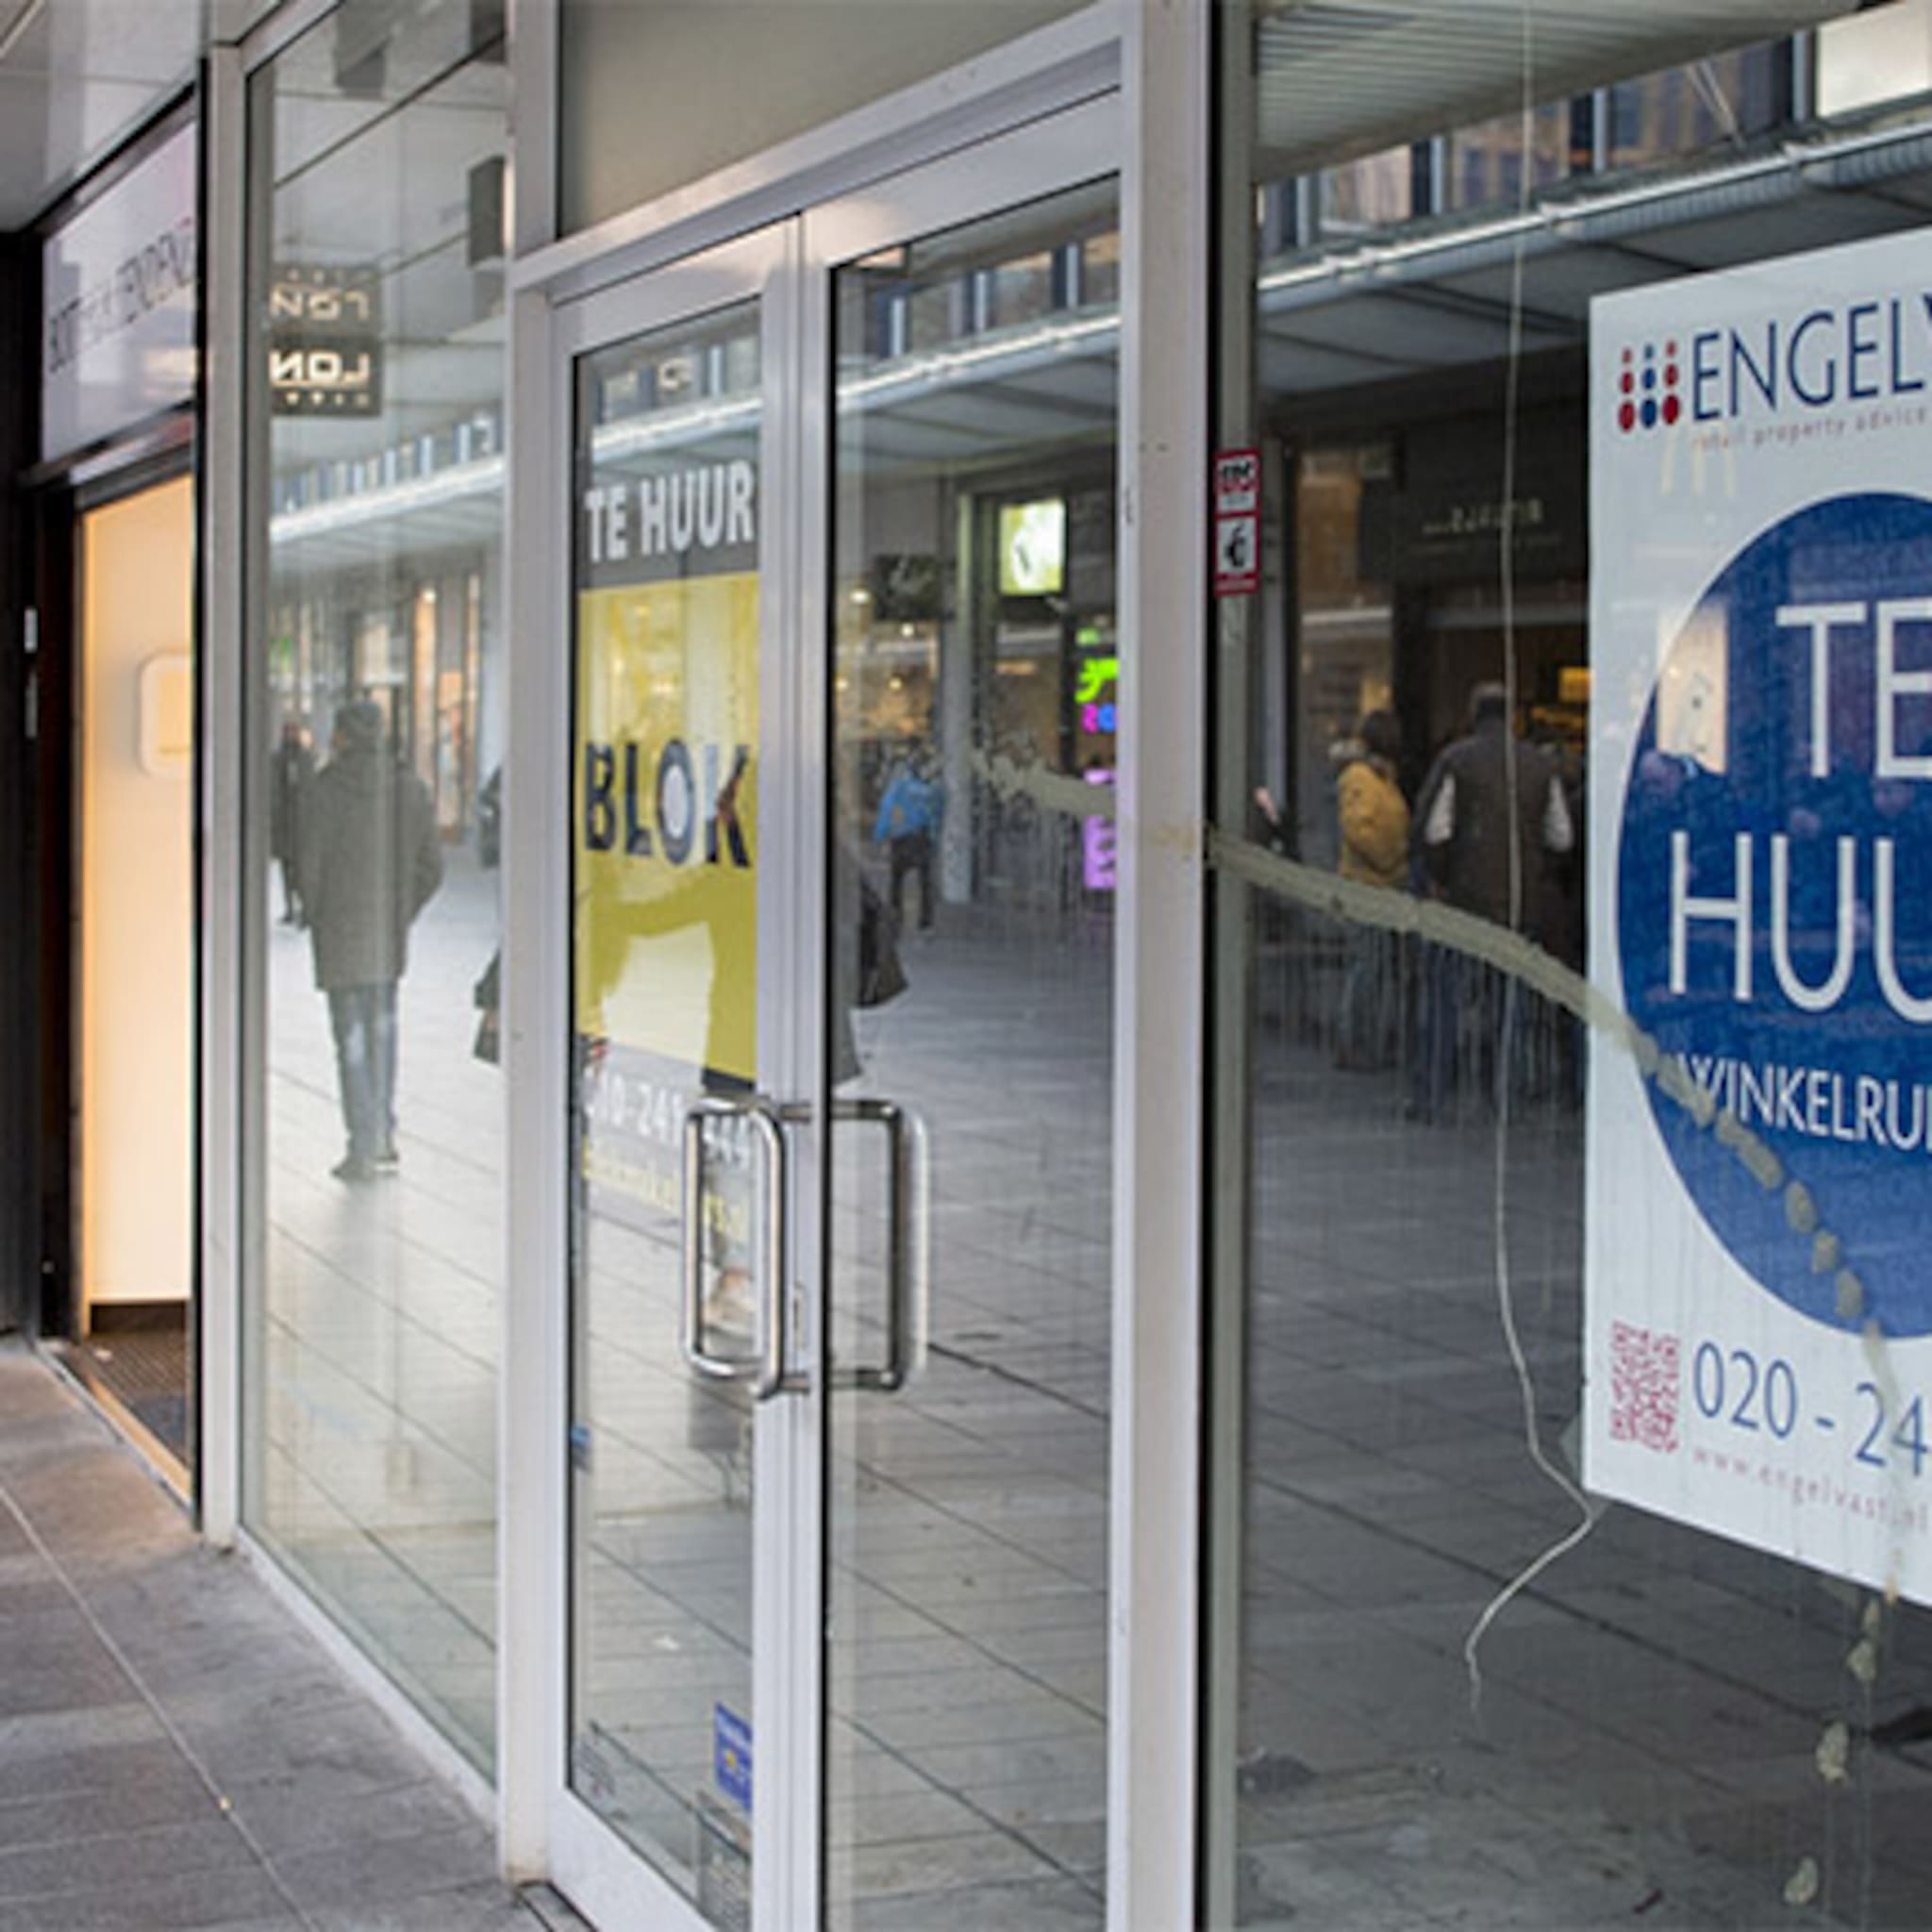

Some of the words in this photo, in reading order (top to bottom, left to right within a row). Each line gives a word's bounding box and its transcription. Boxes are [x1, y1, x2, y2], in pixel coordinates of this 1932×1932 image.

[1692, 291, 1932, 423] ENGEL
[1754, 420, 1844, 448] property
[1856, 407, 1926, 431] advice
[585, 484, 628, 563] TE
[641, 459, 754, 556] HUUR
[1775, 596, 1932, 779] TE
[585, 737, 750, 868] BLOK
